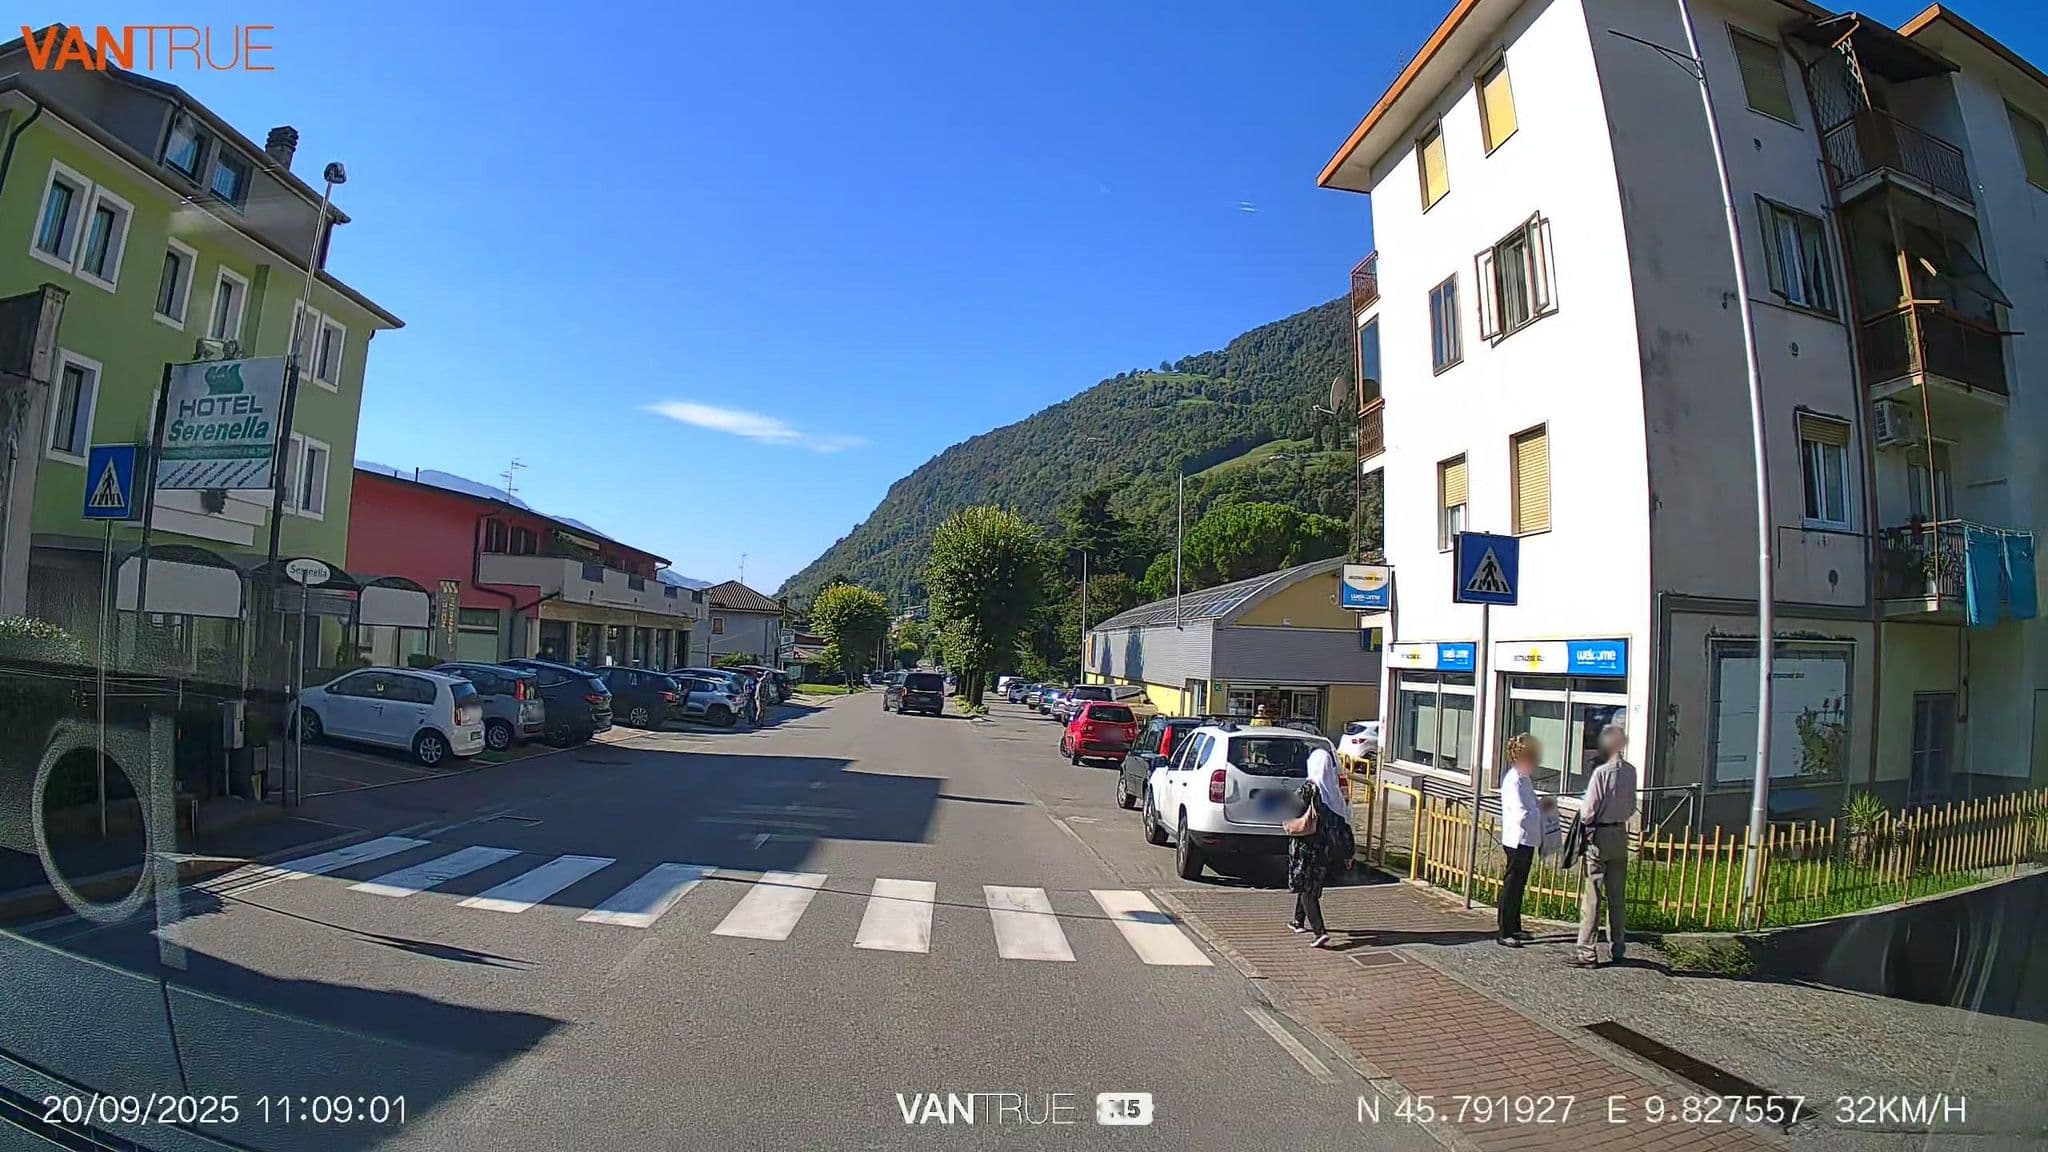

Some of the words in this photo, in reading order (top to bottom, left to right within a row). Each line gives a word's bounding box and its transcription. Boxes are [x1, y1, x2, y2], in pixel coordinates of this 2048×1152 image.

[179, 395, 264, 418] HOTEL
[168, 416, 270, 442] Serenella
[289, 564, 328, 577] Senella
